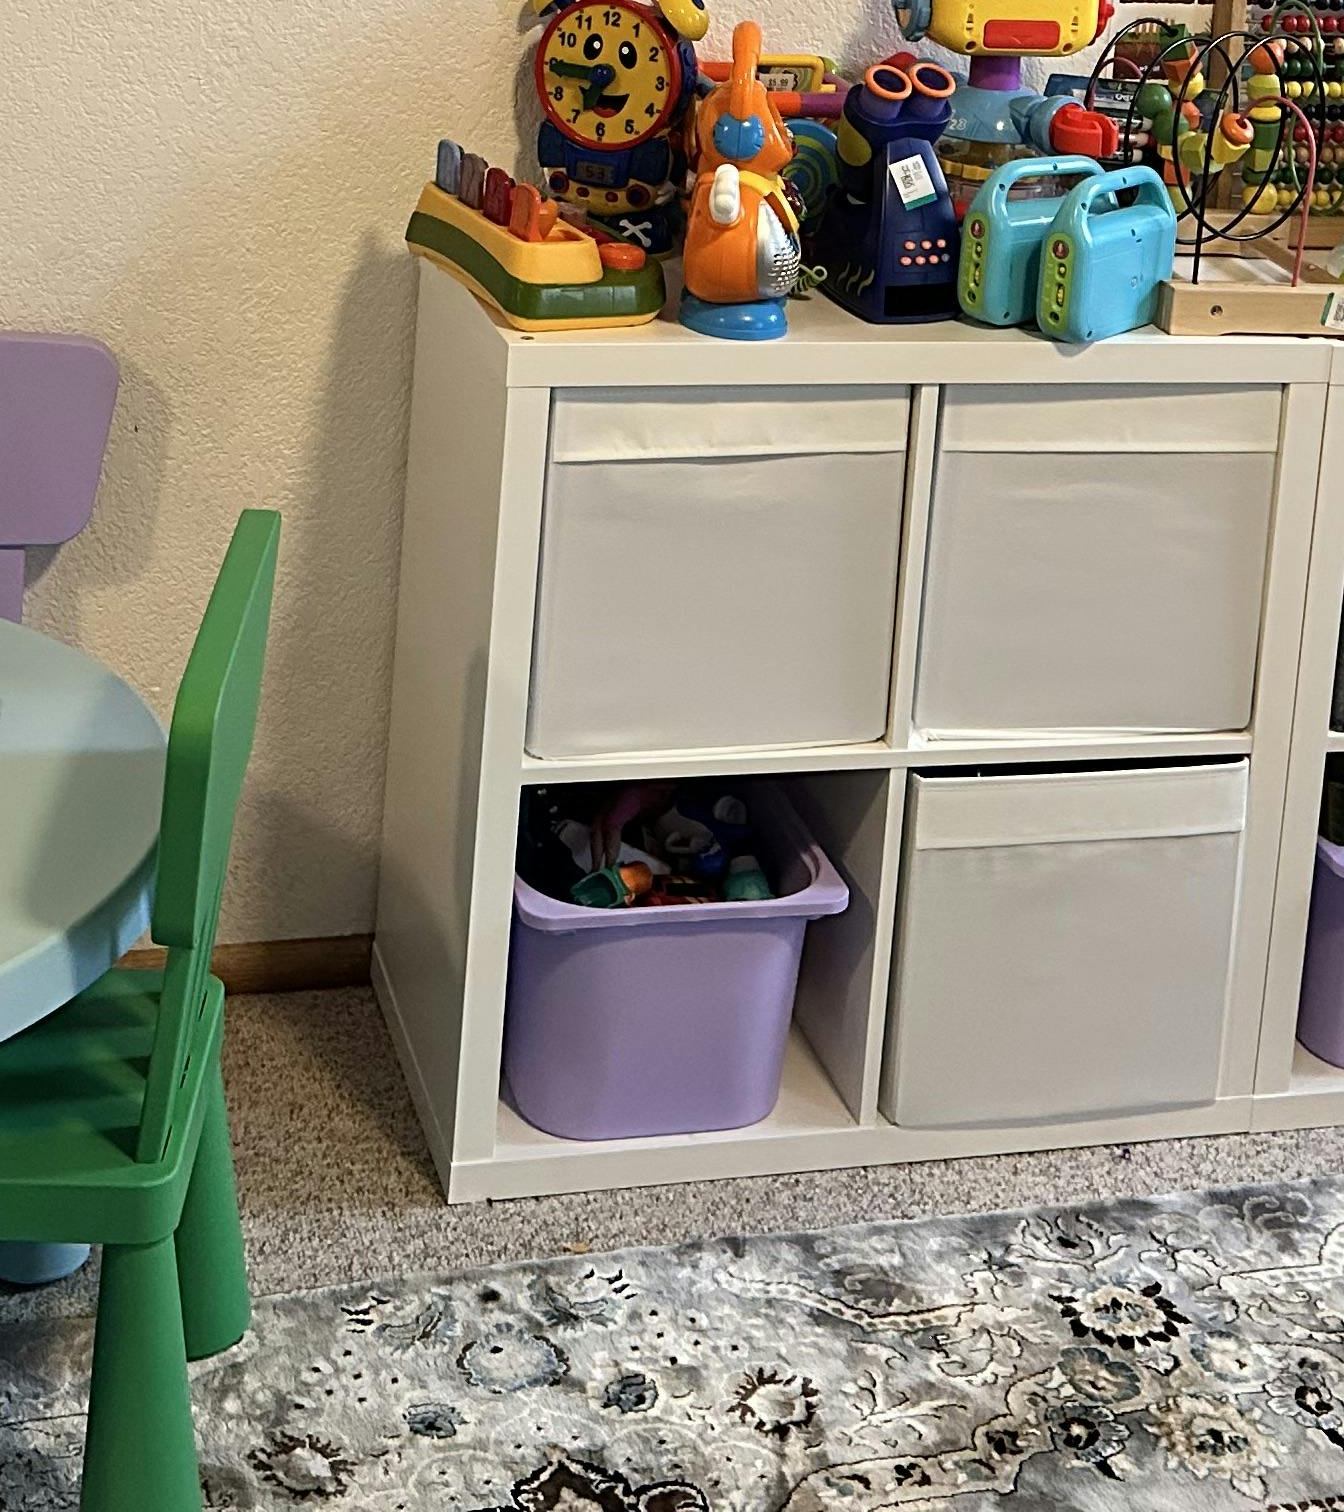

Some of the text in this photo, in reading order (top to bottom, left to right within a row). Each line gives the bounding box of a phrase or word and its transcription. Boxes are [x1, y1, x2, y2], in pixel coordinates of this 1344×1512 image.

[602, 11, 621, 26] 12
[557, 32, 576, 48] 10
[595, 122, 605, 137] 6
